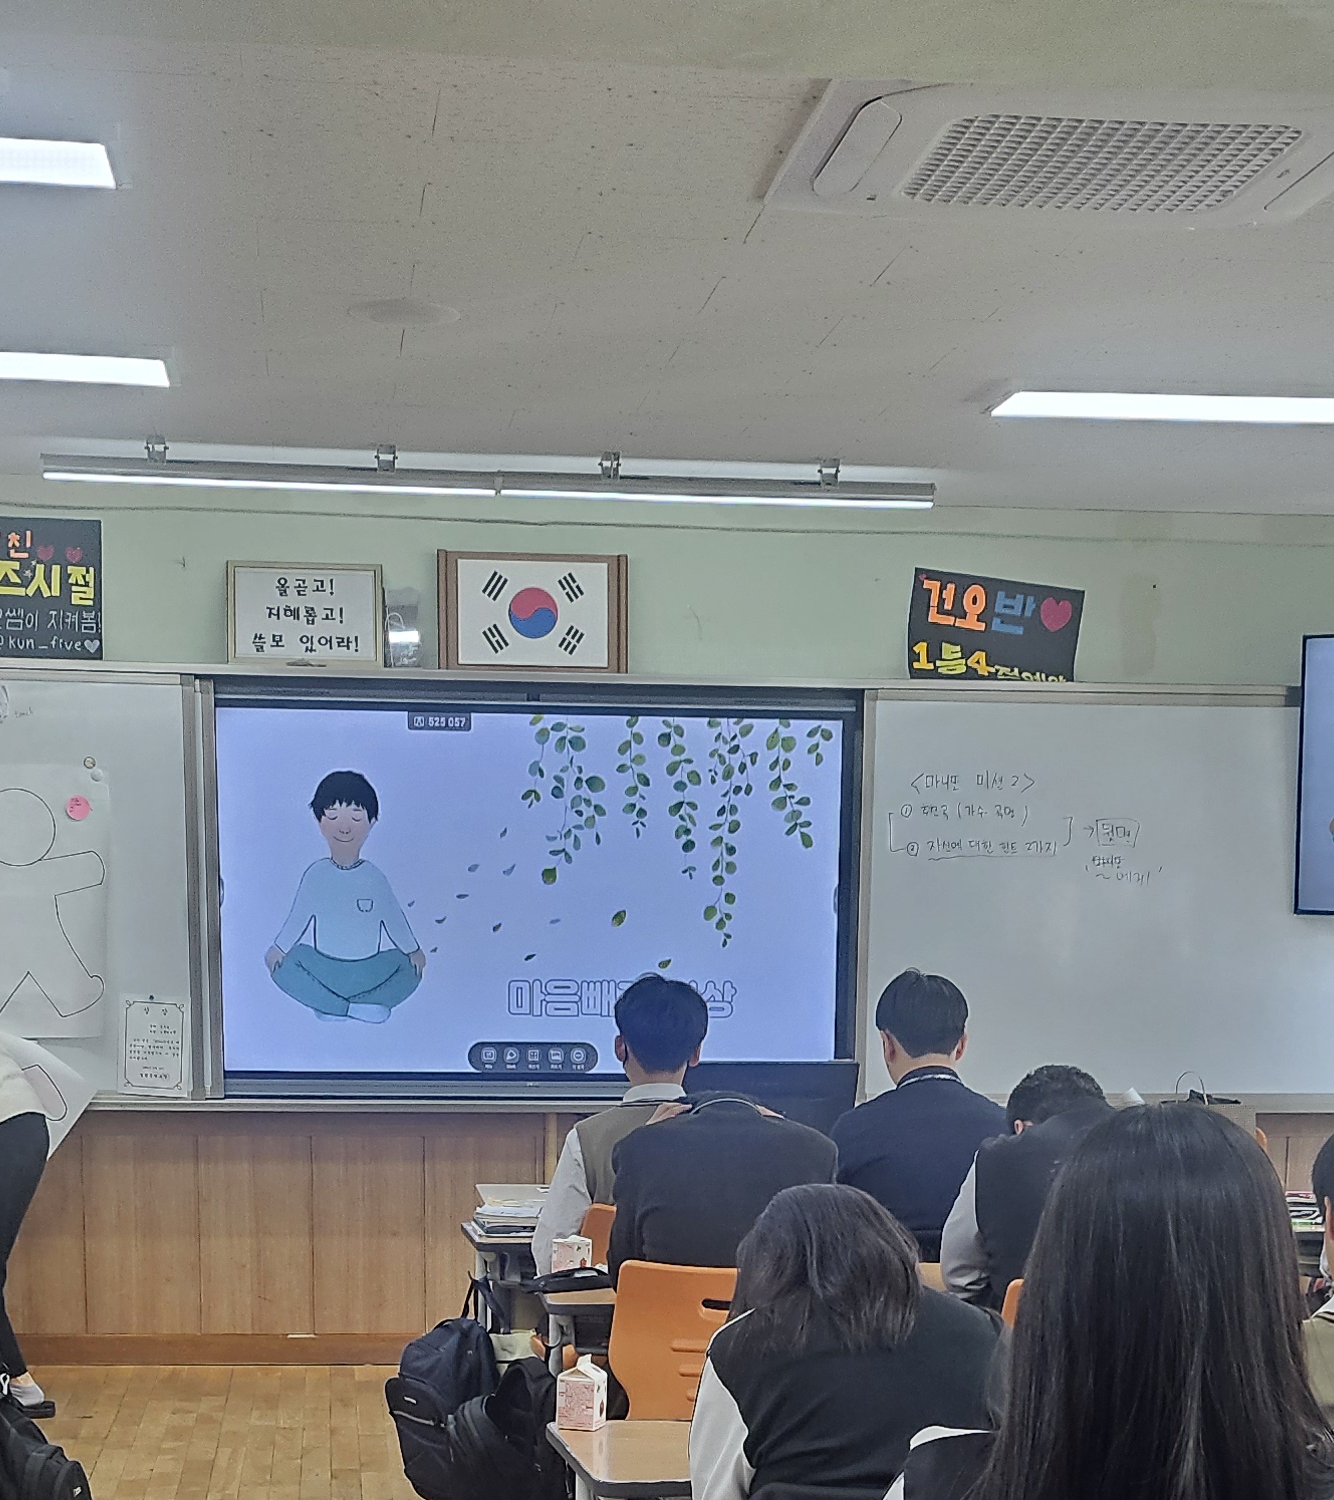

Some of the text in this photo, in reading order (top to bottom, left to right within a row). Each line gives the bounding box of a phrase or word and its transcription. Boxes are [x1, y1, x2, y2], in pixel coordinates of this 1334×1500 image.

[275, 577, 335, 597] 올곧고!
[266, 605, 344, 625] 지혜롭고!
[252, 633, 359, 653] 쓸모 있어라!
[428, 717, 465, 727] 525 057
